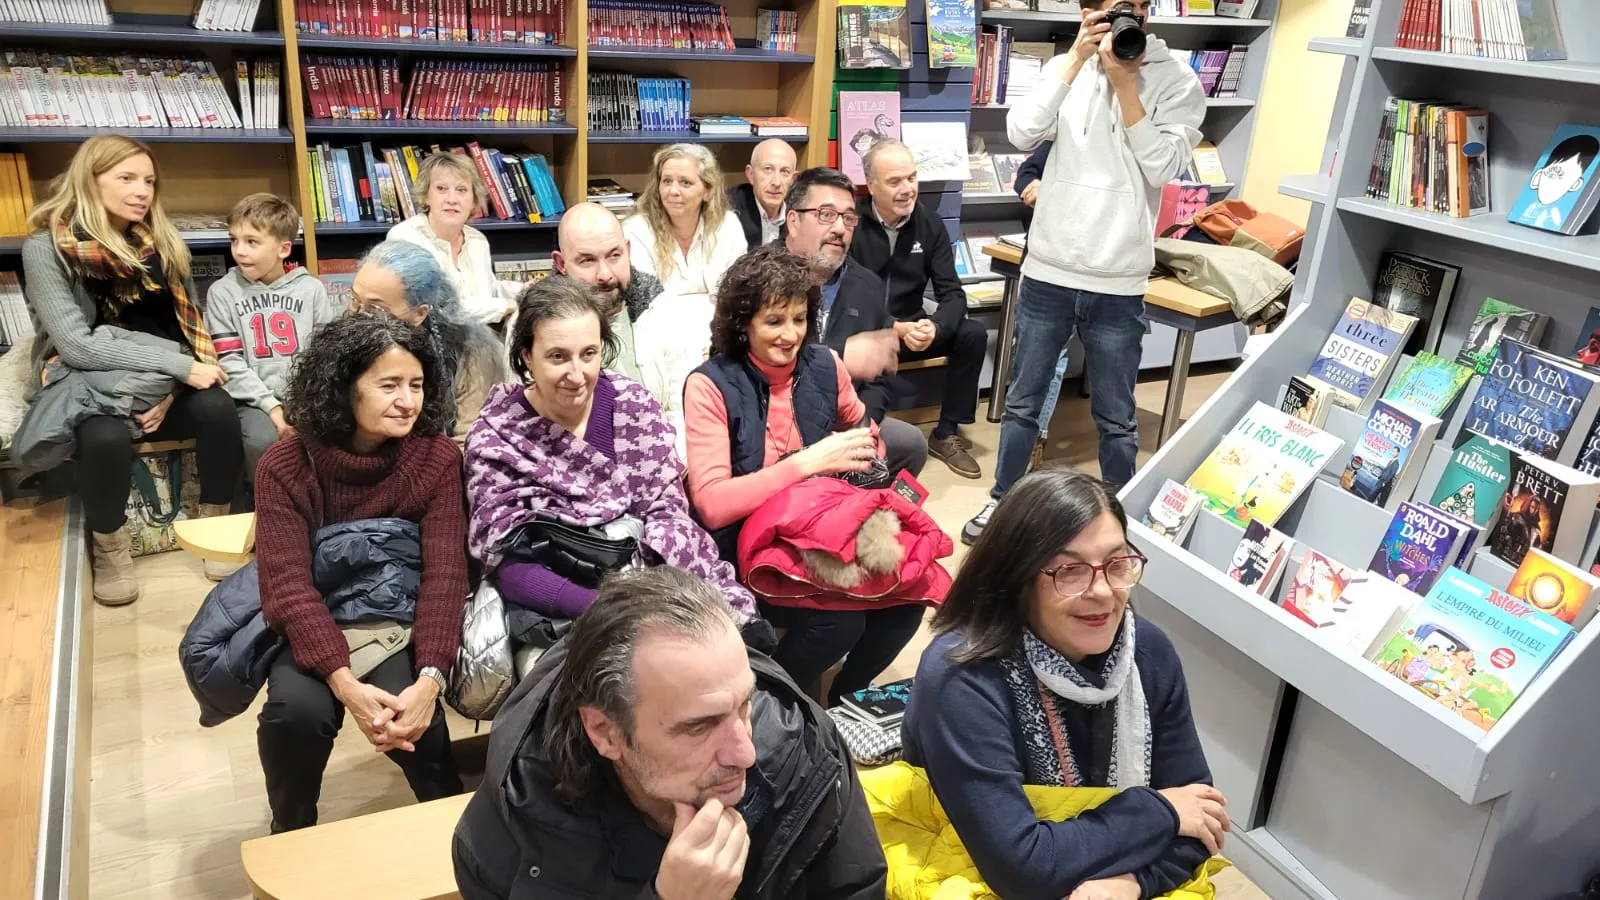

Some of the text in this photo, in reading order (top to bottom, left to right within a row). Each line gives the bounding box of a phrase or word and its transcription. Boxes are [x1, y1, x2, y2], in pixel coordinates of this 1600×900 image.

[126, 70, 138, 92] India
[307, 66, 319, 90] India
[382, 69, 390, 95] México
[554, 77, 562, 106] mundo
[1390, 258, 1430, 284] PATRICK
[235, 293, 303, 317] CHAMPION
[250, 312, 298, 358] 19
[1346, 323, 1389, 347] three
[1328, 340, 1380, 372] SISTERS
[1326, 364, 1360, 384] HEATHER
[1326, 372, 1353, 389] MORRIS
[1534, 365, 1569, 390] KEN
[1509, 373, 1581, 415] FOLLETT
[1373, 410, 1412, 438] MICHAEL
[1519, 404, 1544, 425] The
[1367, 420, 1412, 448] CONNELLY
[1494, 411, 1560, 449] ARMOUR
[1455, 451, 1506, 484] Hustler
[1470, 450, 1488, 465] The
[1525, 464, 1550, 484] PETER
[1515, 470, 1564, 505] BRETT
[1403, 508, 1449, 539] ROALD
[1399, 522, 1437, 552] DAHL
[1395, 539, 1431, 565] WITCHES
[1436, 590, 1486, 621] L'EMPIRE
[1485, 614, 1502, 630] DU
[1502, 623, 1547, 653] MILIEU
